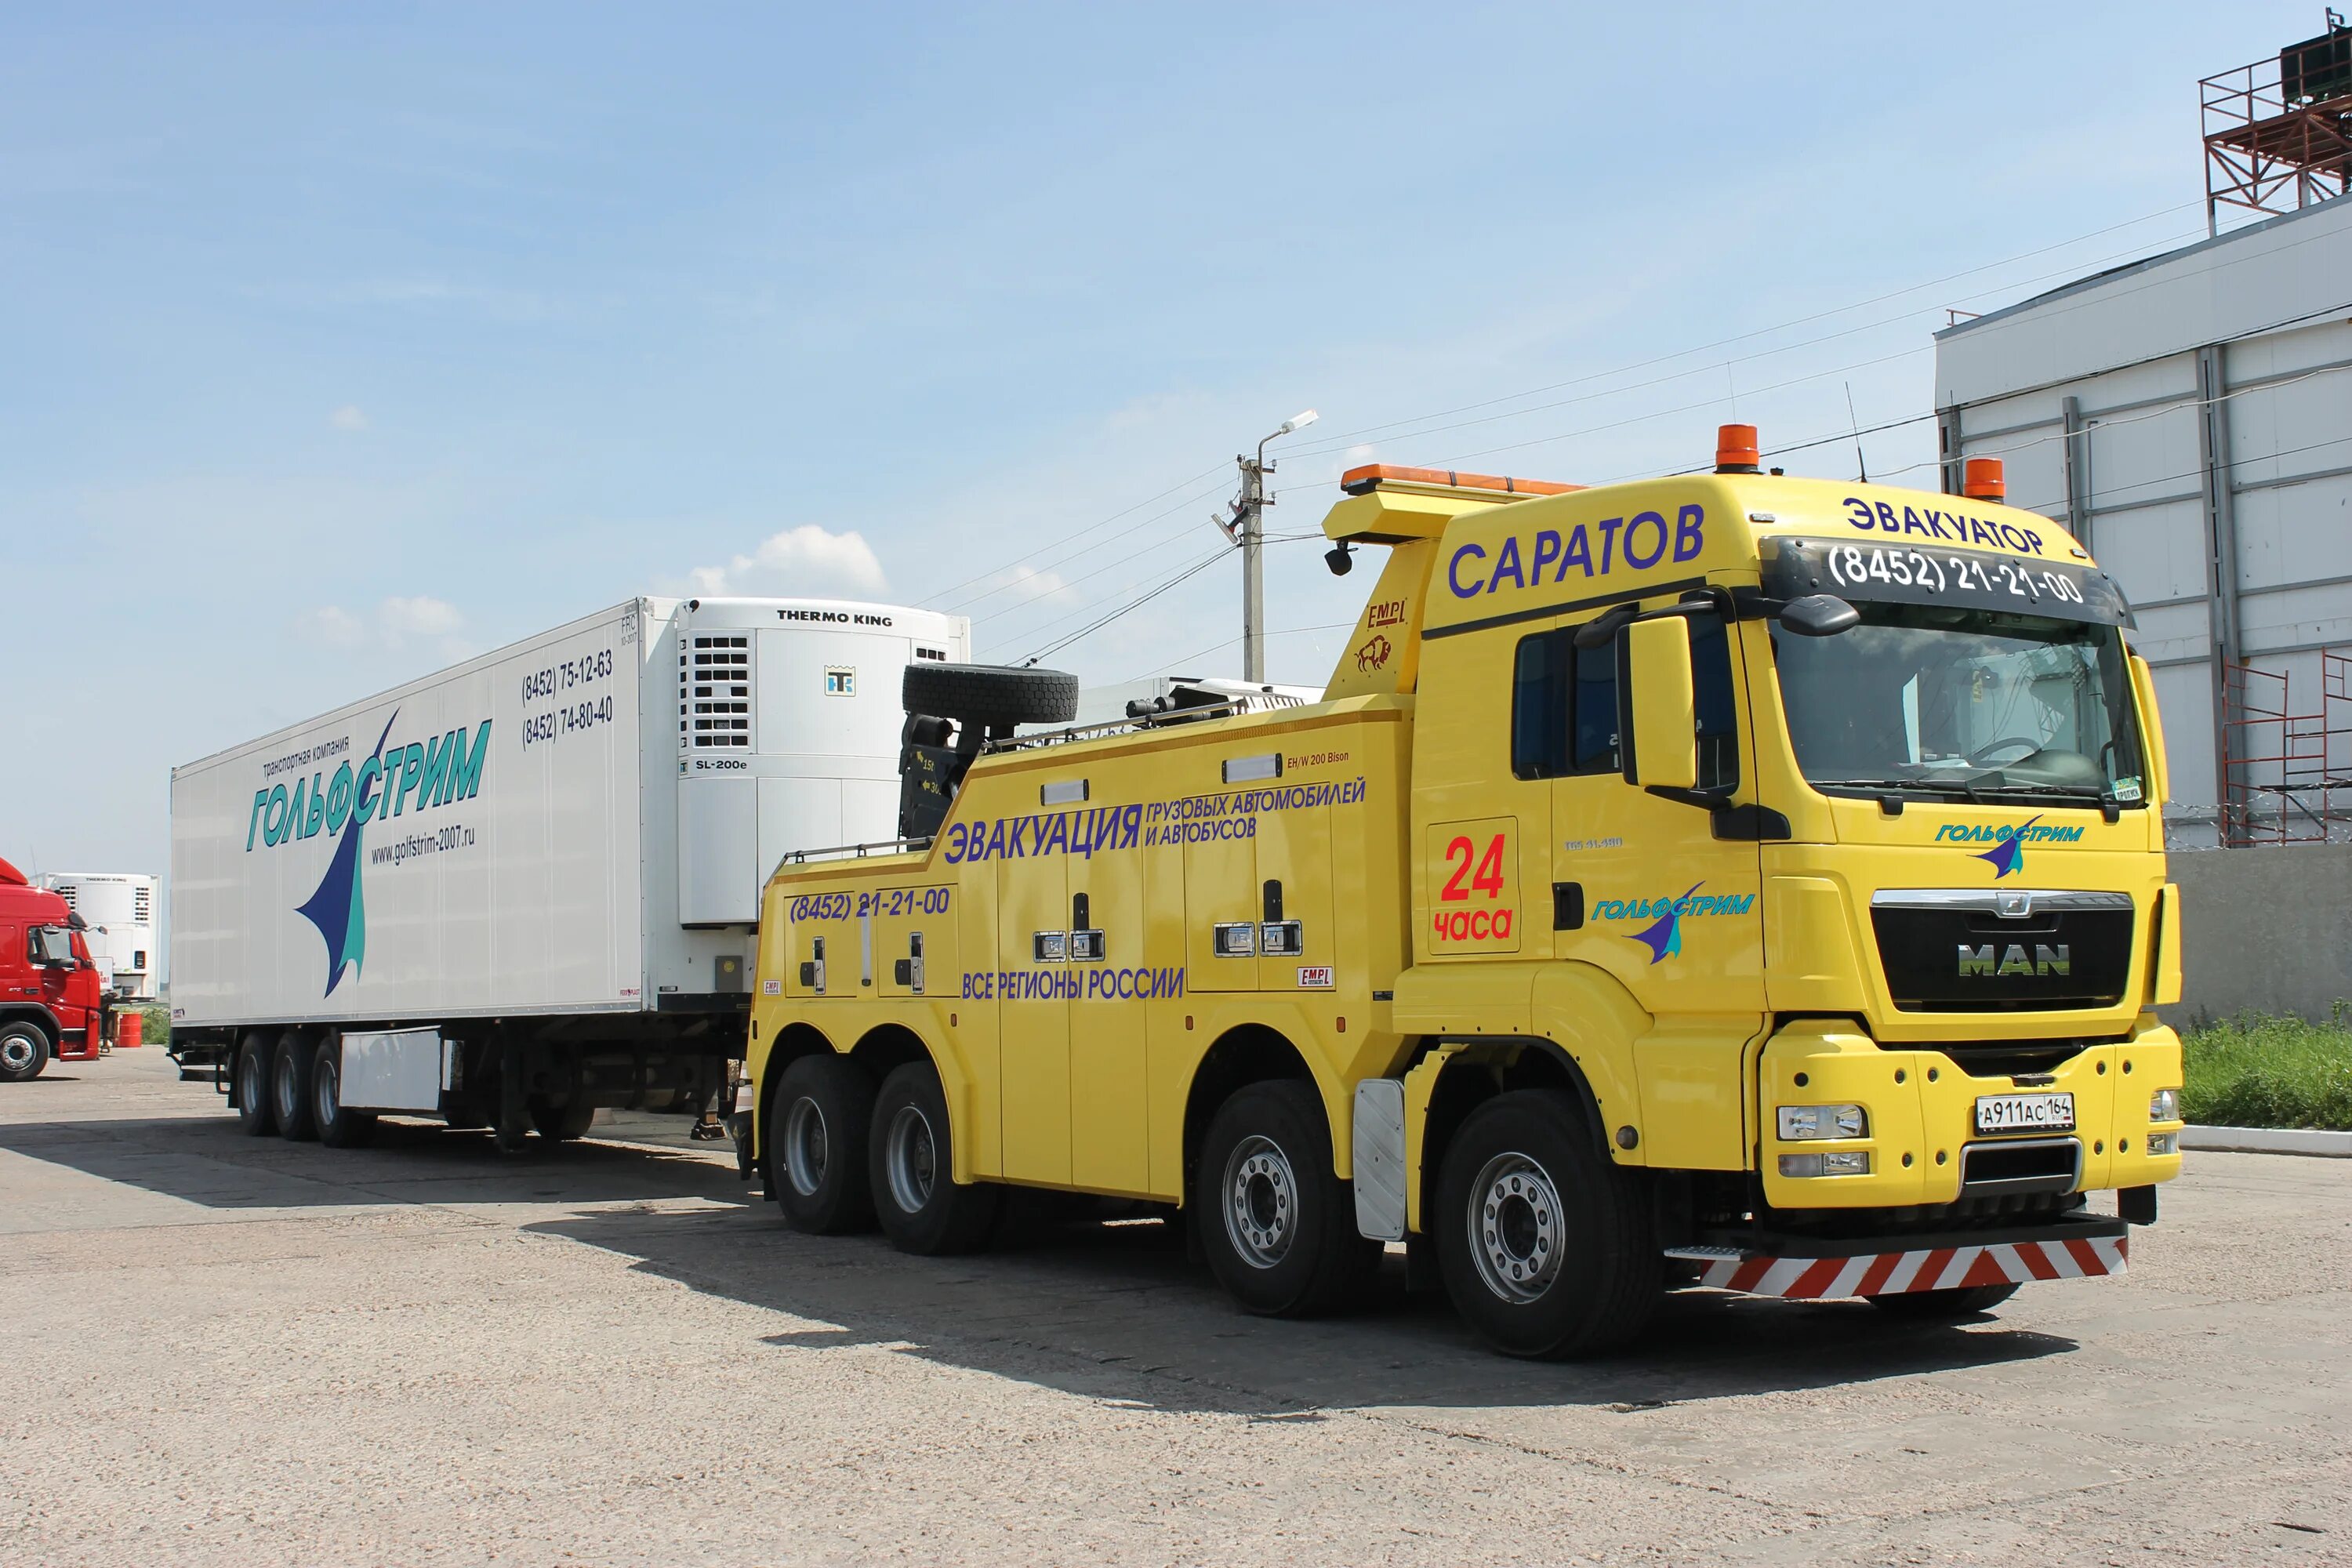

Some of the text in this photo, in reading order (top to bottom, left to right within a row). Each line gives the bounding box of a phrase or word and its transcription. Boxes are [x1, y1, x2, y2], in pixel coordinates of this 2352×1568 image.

[1842, 496, 2042, 555] ЭВАКУАТОР
[1448, 503, 1704, 599] САРАТОВ
[1829, 546, 2083, 604] (8452) 21-21-00
[621, 614, 636, 633] FRC
[777, 609, 892, 627] THERMO KING
[1367, 600, 1405, 628] EMPL
[521, 648, 613, 708] (8452) 75-12-63
[521, 695, 613, 752] (8452) 74-80-40
[263, 735, 350, 782] транспортная компания
[696, 760, 747, 769] SL-200e
[923, 758, 935, 771] 15t
[1287, 750, 1349, 769] EH/W 200 Bison
[246, 719, 493, 852] ГОЛЬФСТРИМ
[931, 782, 942, 796] 30
[944, 776, 1366, 864] ЭВАКУАЦИЯ ГРУЗОВЫХ АВТОМОБИЛЕЙ
[1145, 818, 1257, 847] И АВТОБУСОВ
[1934, 825, 2085, 843] ГОЛЬФСТРИМ
[372, 824, 475, 867] www.golfstrim-2007.ru
[1440, 833, 1505, 902] 24
[789, 887, 949, 924] (8452) 21-21-00
[1591, 894, 1755, 921] ГОЛЬФСТРИМ
[1433, 908, 1513, 942] часа
[1958, 944, 2070, 976] MAN
[962, 967, 1185, 1000] ВСЕ РЕГИОНЫ РОССИИ
[1301, 969, 1330, 985] EMPL
[2047, 1098, 2069, 1114] 164
